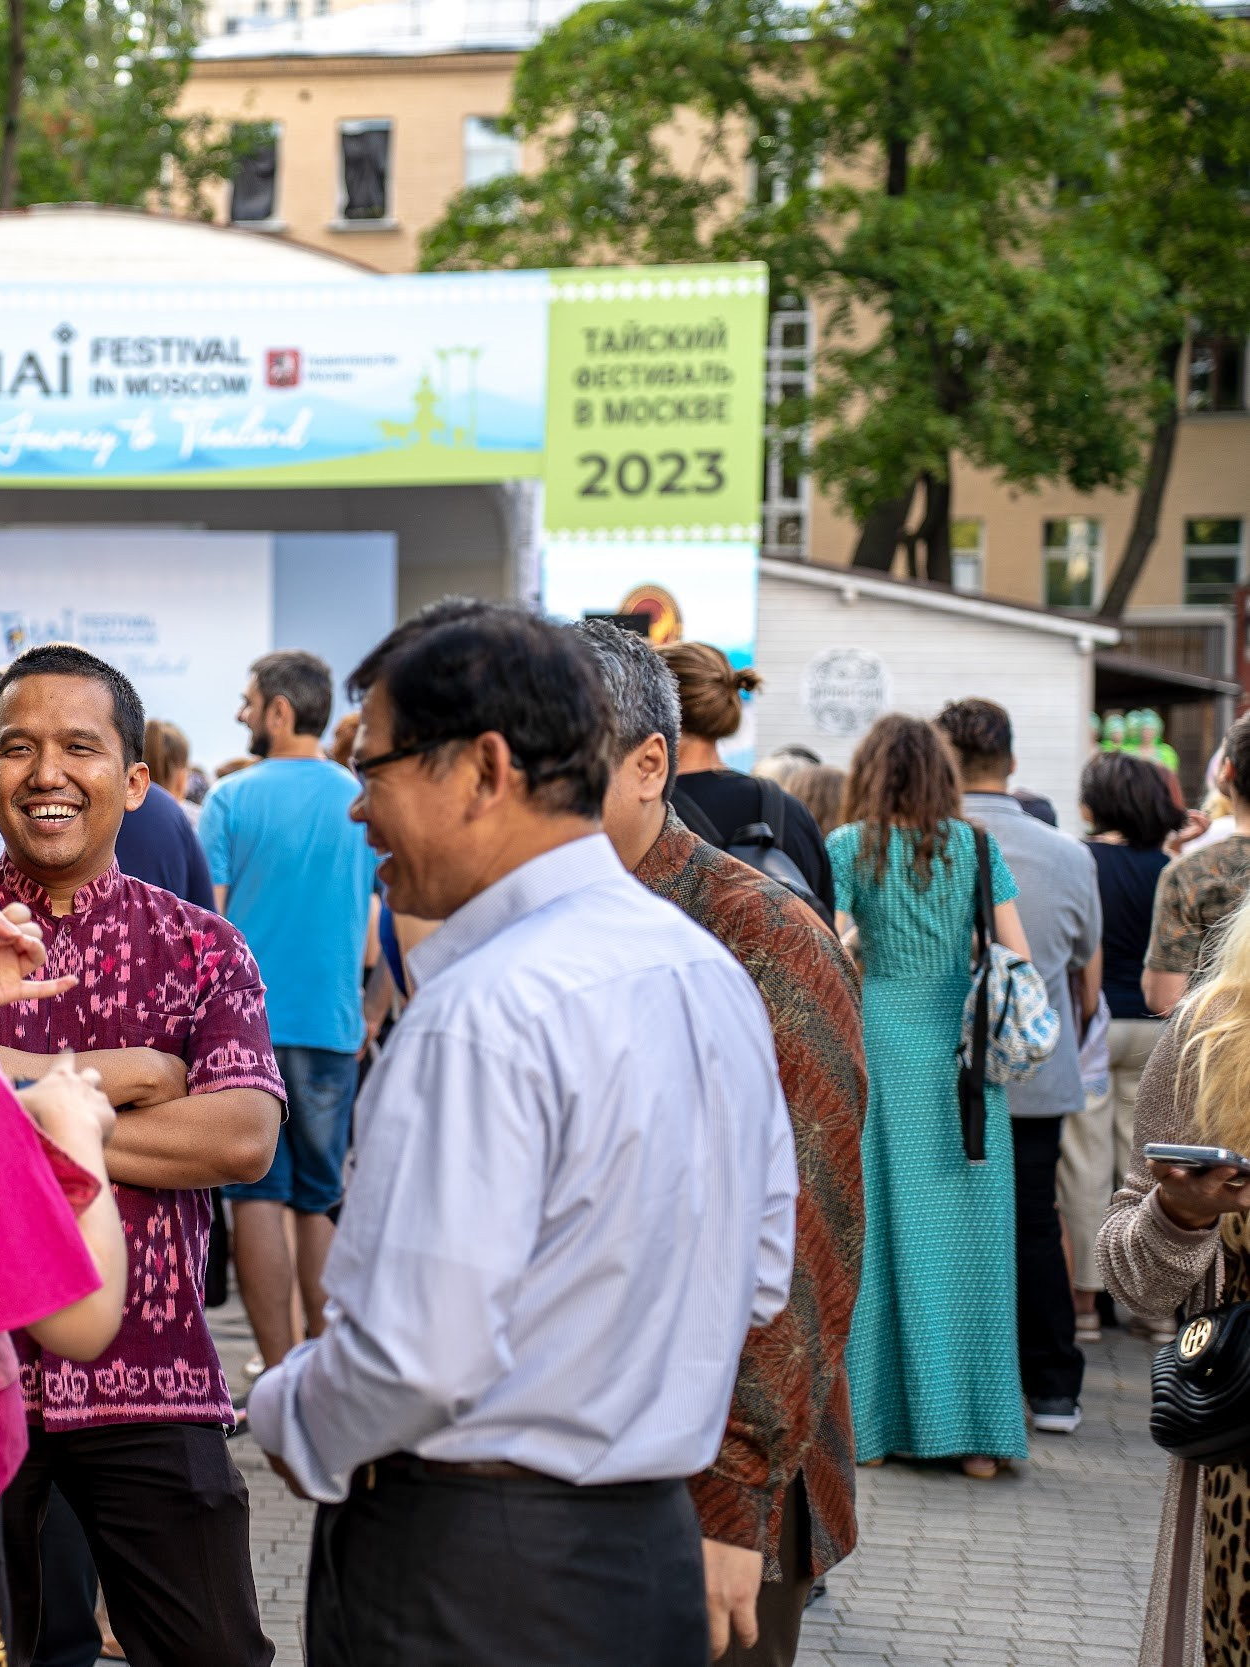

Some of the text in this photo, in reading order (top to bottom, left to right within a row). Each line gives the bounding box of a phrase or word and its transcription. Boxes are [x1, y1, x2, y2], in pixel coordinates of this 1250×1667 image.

[582, 318, 727, 352] ТАЙСКИЙ
[90, 337, 245, 365] FESTIVAL
[91, 375, 248, 395] IN MOSCOW
[574, 363, 732, 388] ФЕСТИВАЛЬ
[574, 395, 731, 427] В МОСКВЕ
[578, 451, 726, 497] 2023
